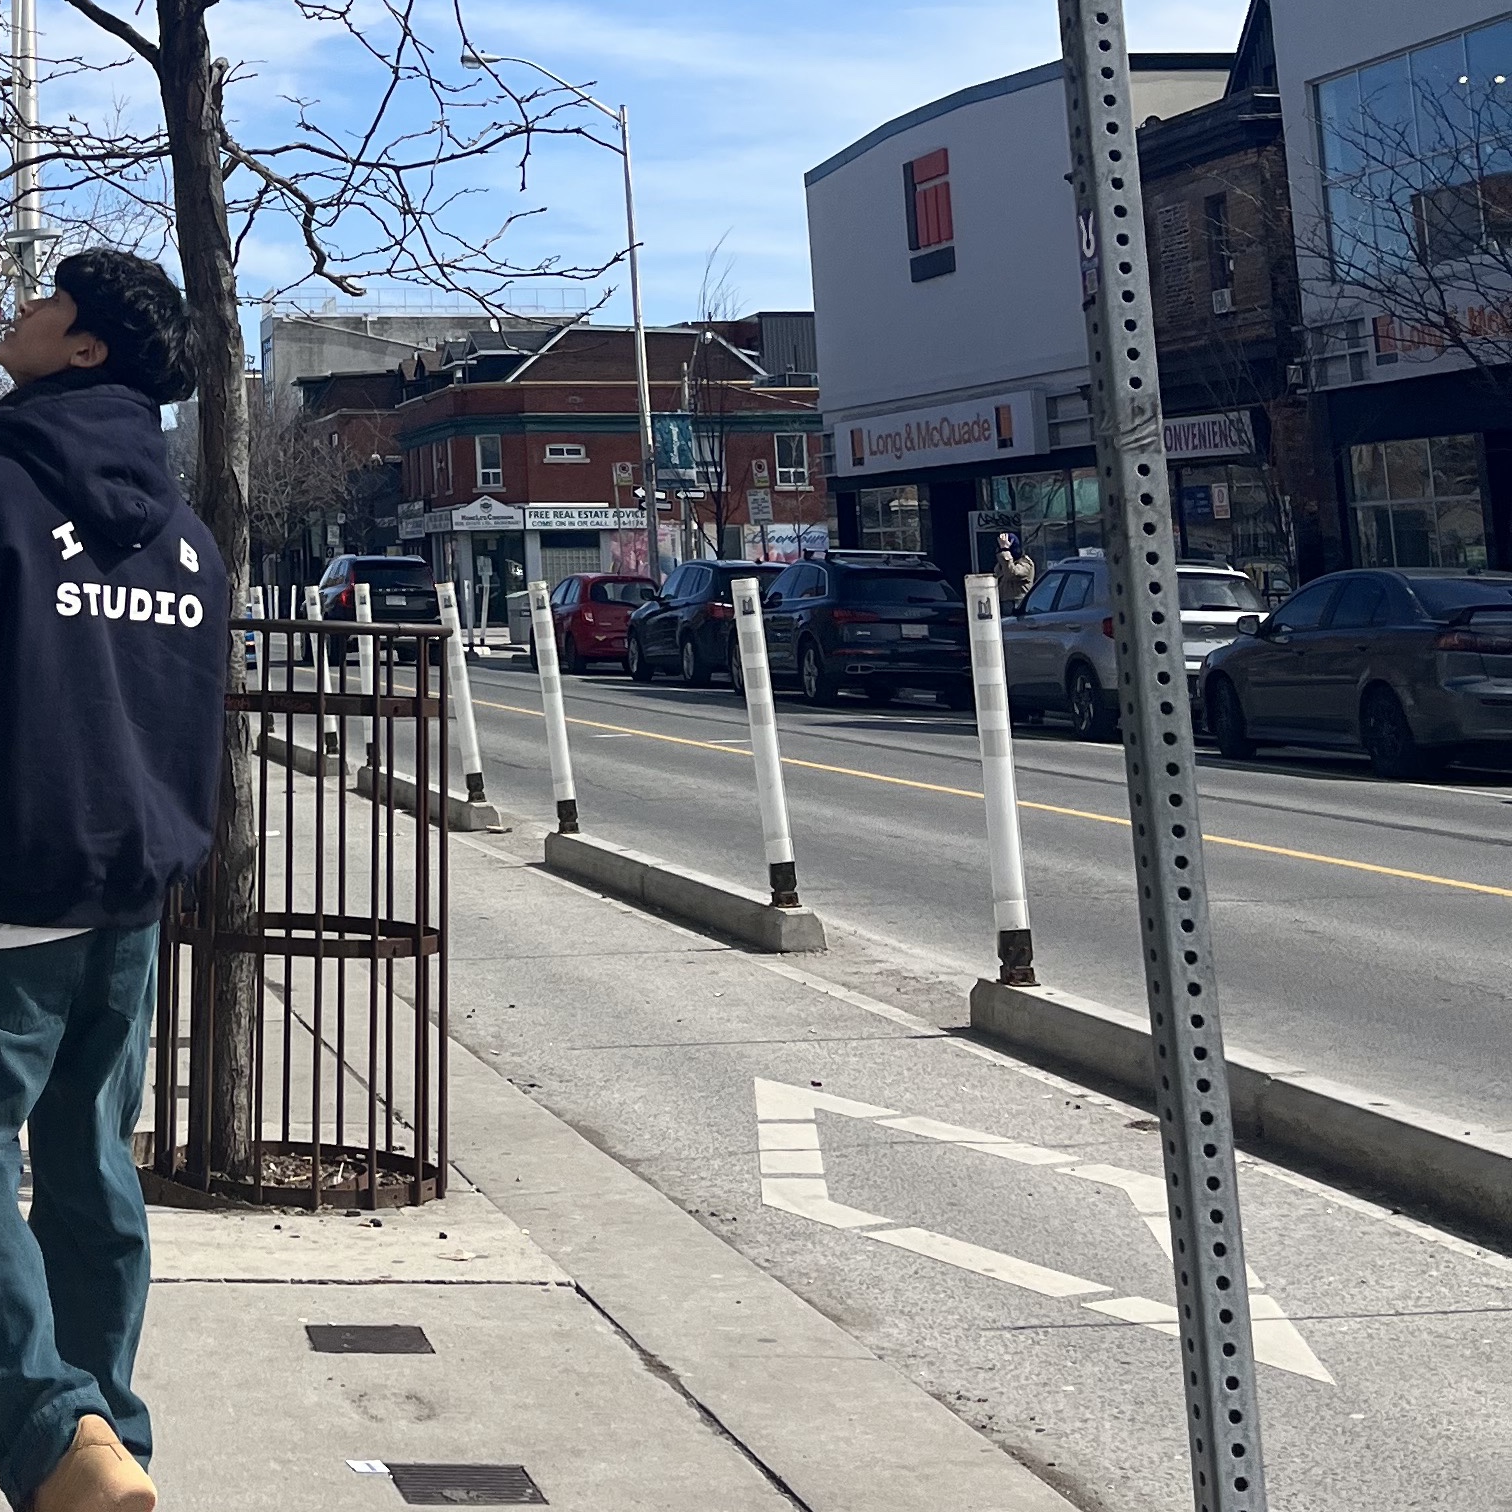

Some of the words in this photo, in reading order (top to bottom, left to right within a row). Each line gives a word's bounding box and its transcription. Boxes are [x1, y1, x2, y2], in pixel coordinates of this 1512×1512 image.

[868, 429, 903, 460] Long
[916, 413, 991, 450] McQuade
[529, 511, 551, 519] FREE
[553, 511, 575, 519] REAL
[578, 511, 609, 519] ESTATE
[612, 510, 645, 519] ADVICE
[51, 521, 84, 560] I
[180, 537, 199, 573] B
[56, 582, 203, 628] STUDIO
